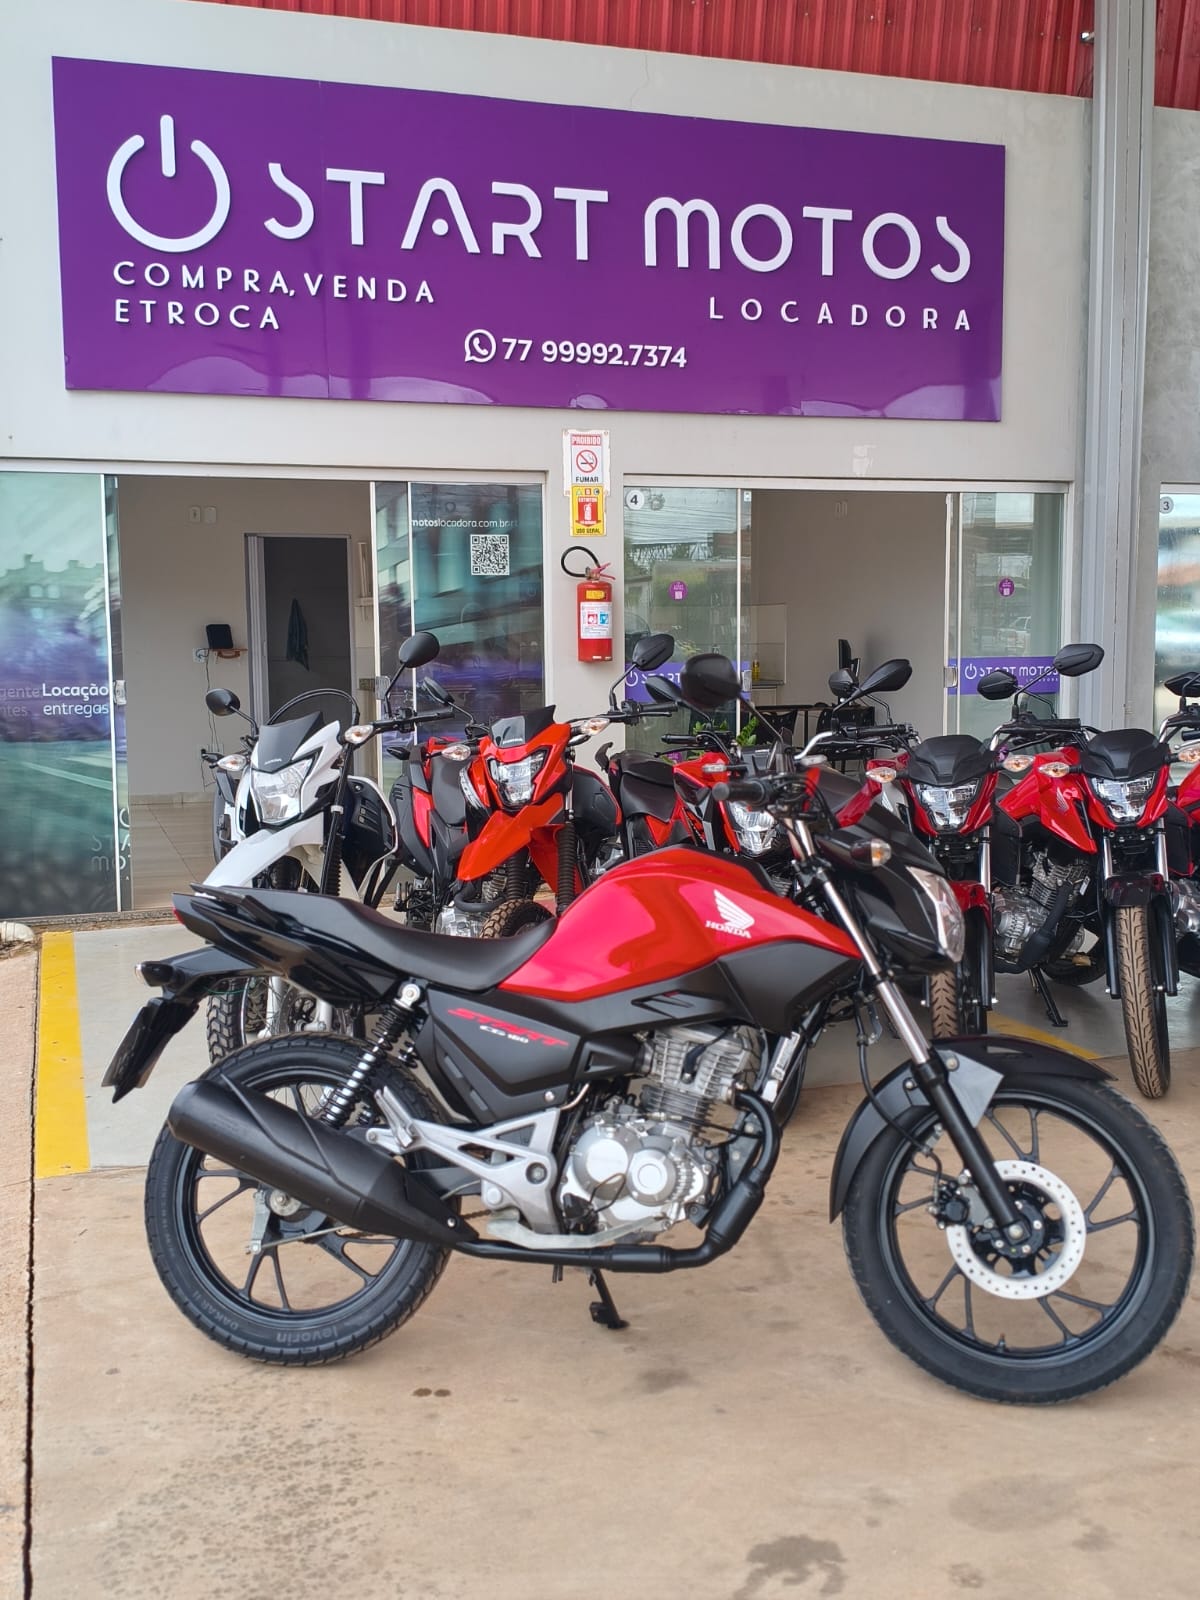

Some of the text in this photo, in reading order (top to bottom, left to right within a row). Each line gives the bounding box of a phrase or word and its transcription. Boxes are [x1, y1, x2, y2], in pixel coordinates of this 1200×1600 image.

[263, 162, 971, 283] START MOTOS
[709, 297, 971, 332] LOCADORA
[502, 338, 688, 369] 77 99992.7374
[630, 494, 639, 505] 4
[1162, 500, 1170, 511] 3
[42, 683, 109, 701] Locação
[43, 703, 109, 718] entregas
[705, 920, 752, 939] HONDA
[276, 1325, 338, 1347] levorin
